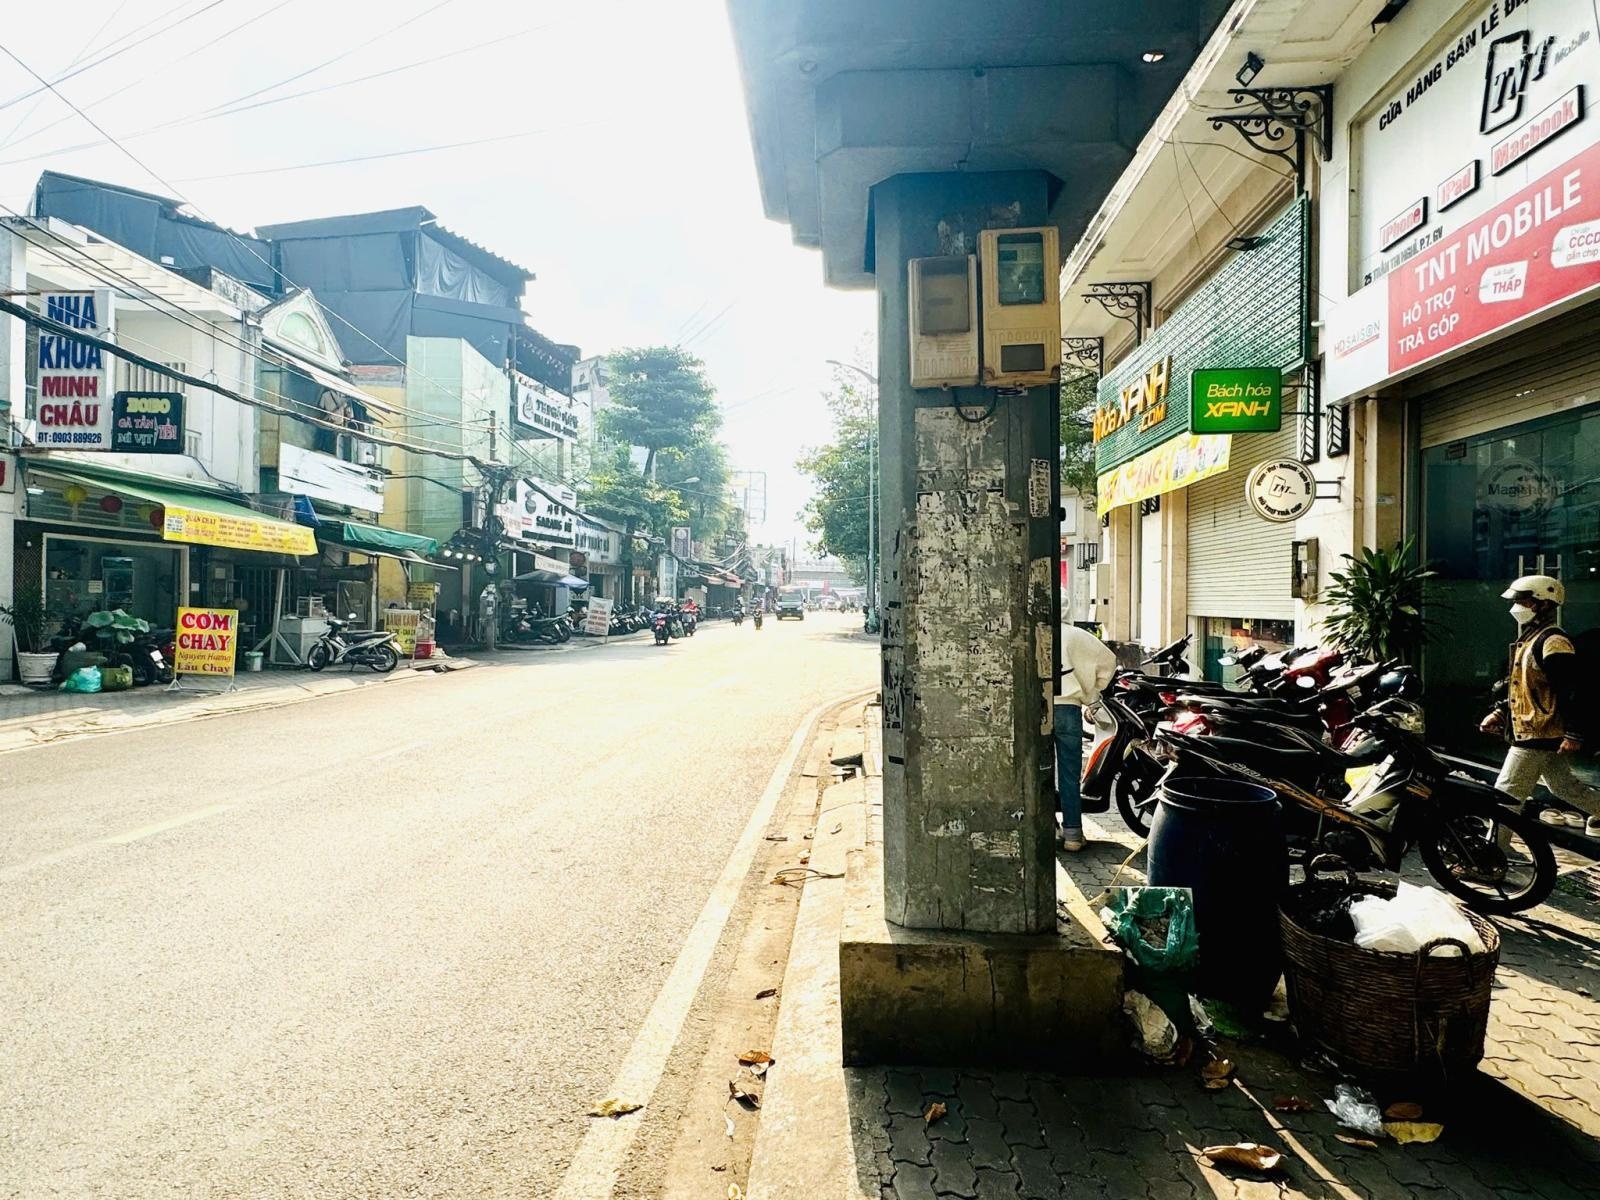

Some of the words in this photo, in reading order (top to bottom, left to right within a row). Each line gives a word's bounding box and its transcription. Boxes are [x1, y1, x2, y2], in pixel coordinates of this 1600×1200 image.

[1379, 99, 1402, 131] CỬA
[1406, 64, 1442, 109] HÀNG
[1446, 29, 1477, 71] BÁN
[1480, 3, 1498, 39] LẺ
[1493, 98, 1575, 171] Macbook
[1415, 242, 1460, 293] TNT
[1466, 169, 1582, 265] MOBILE
[1493, 274, 1522, 294] THẤP
[47, 296, 97, 329] NHA
[1427, 311, 1460, 341] GÓP
[42, 376, 98, 397] MINH
[1118, 355, 1173, 426] XANH
[1207, 383, 1242, 398] Bách
[1246, 382, 1272, 397] hóa
[40, 401, 100, 427] CHÂU
[1203, 401, 1271, 418] XANH
[52, 432, 72, 443] 0903
[73, 432, 102, 443] 889926
[1273, 483, 1291, 493] TNT
[178, 633, 232, 651] CHAY
[202, 663, 231, 673] Chay
